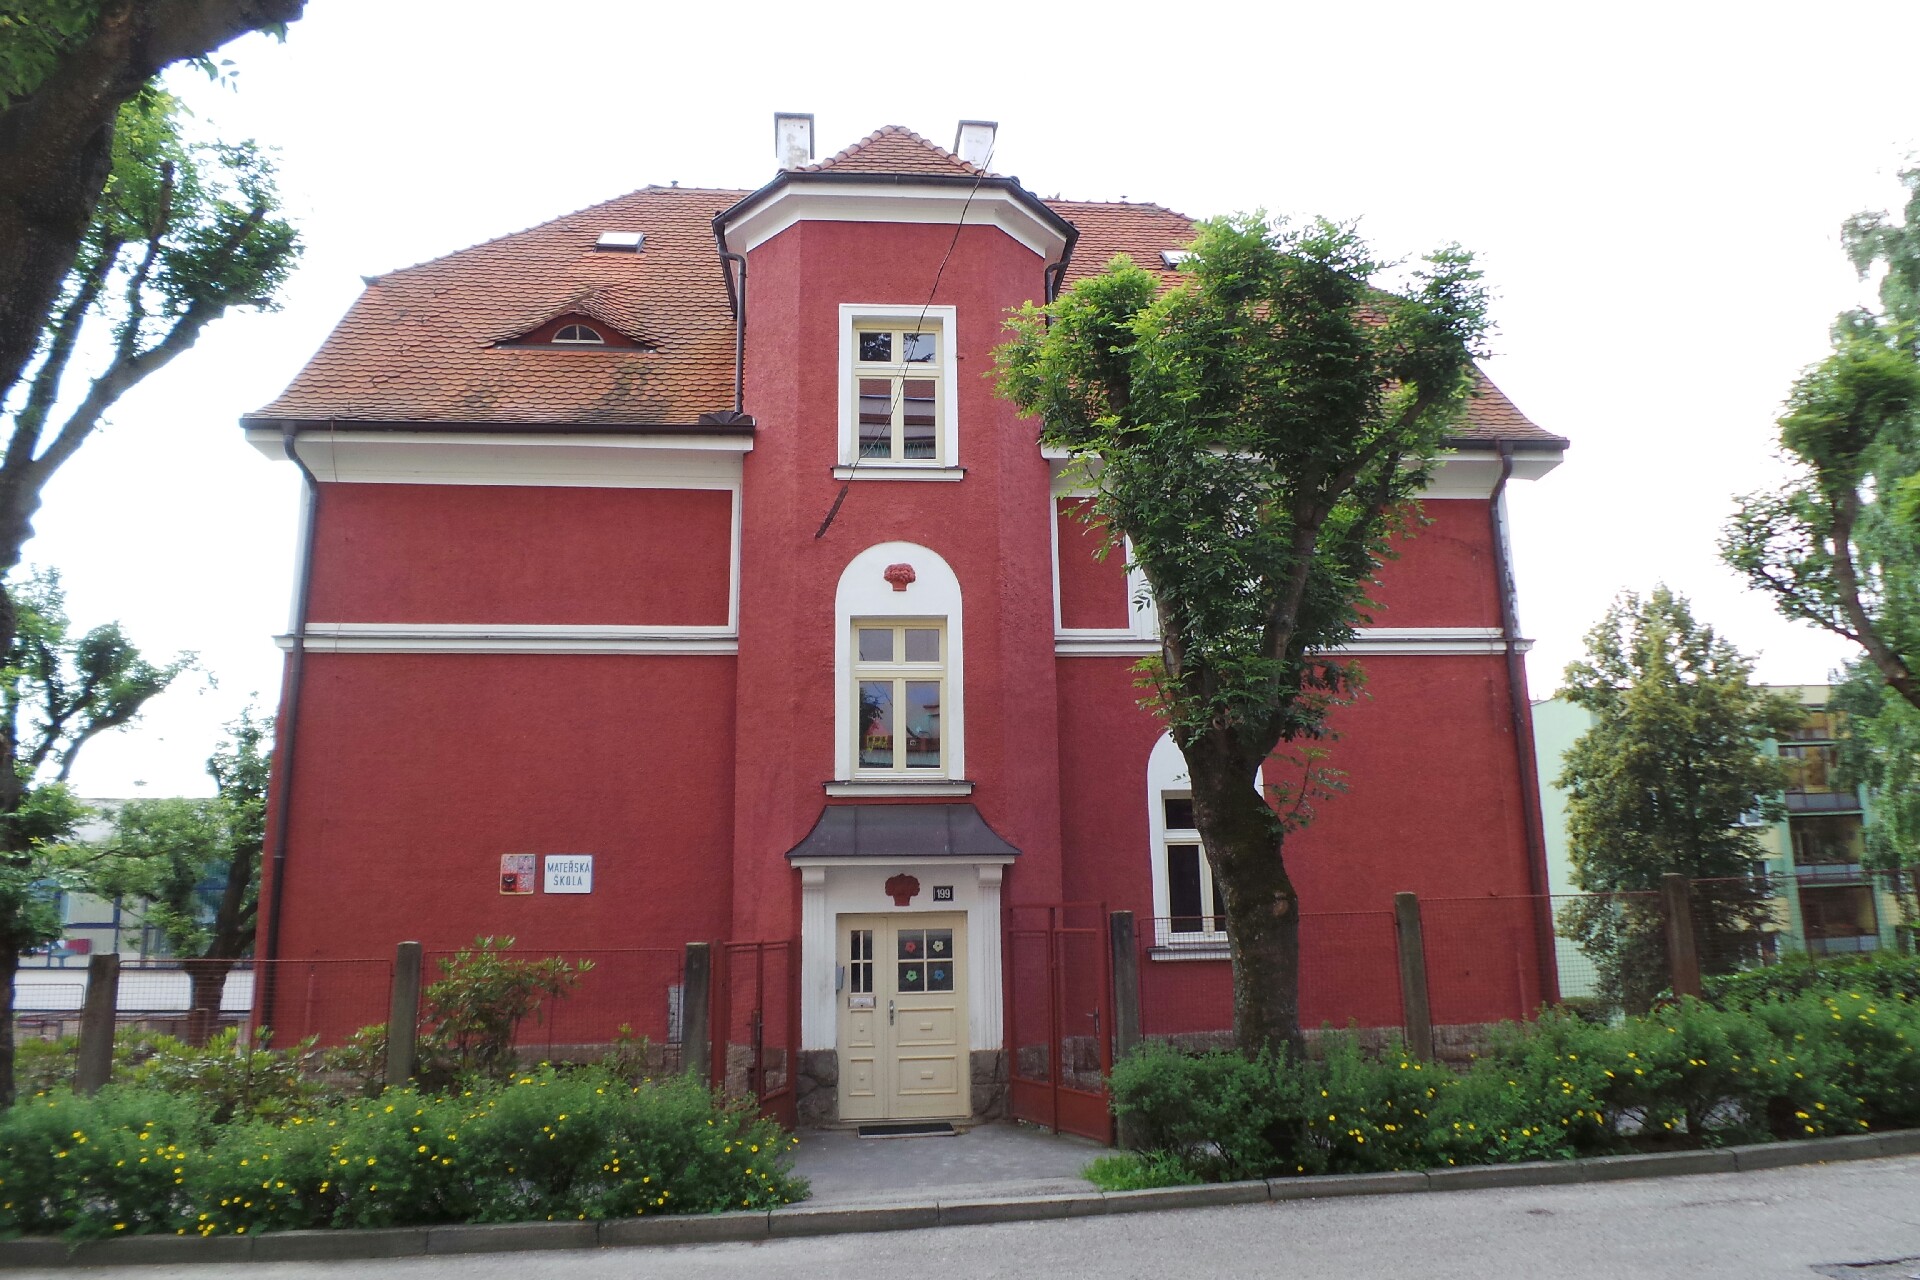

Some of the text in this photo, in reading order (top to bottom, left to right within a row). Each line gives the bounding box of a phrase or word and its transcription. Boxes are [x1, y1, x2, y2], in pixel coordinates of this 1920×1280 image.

[547, 860, 590, 873] MATEŘSKÁ
[553, 874, 583, 886] ŠKOLA
[936, 888, 951, 899] 199
